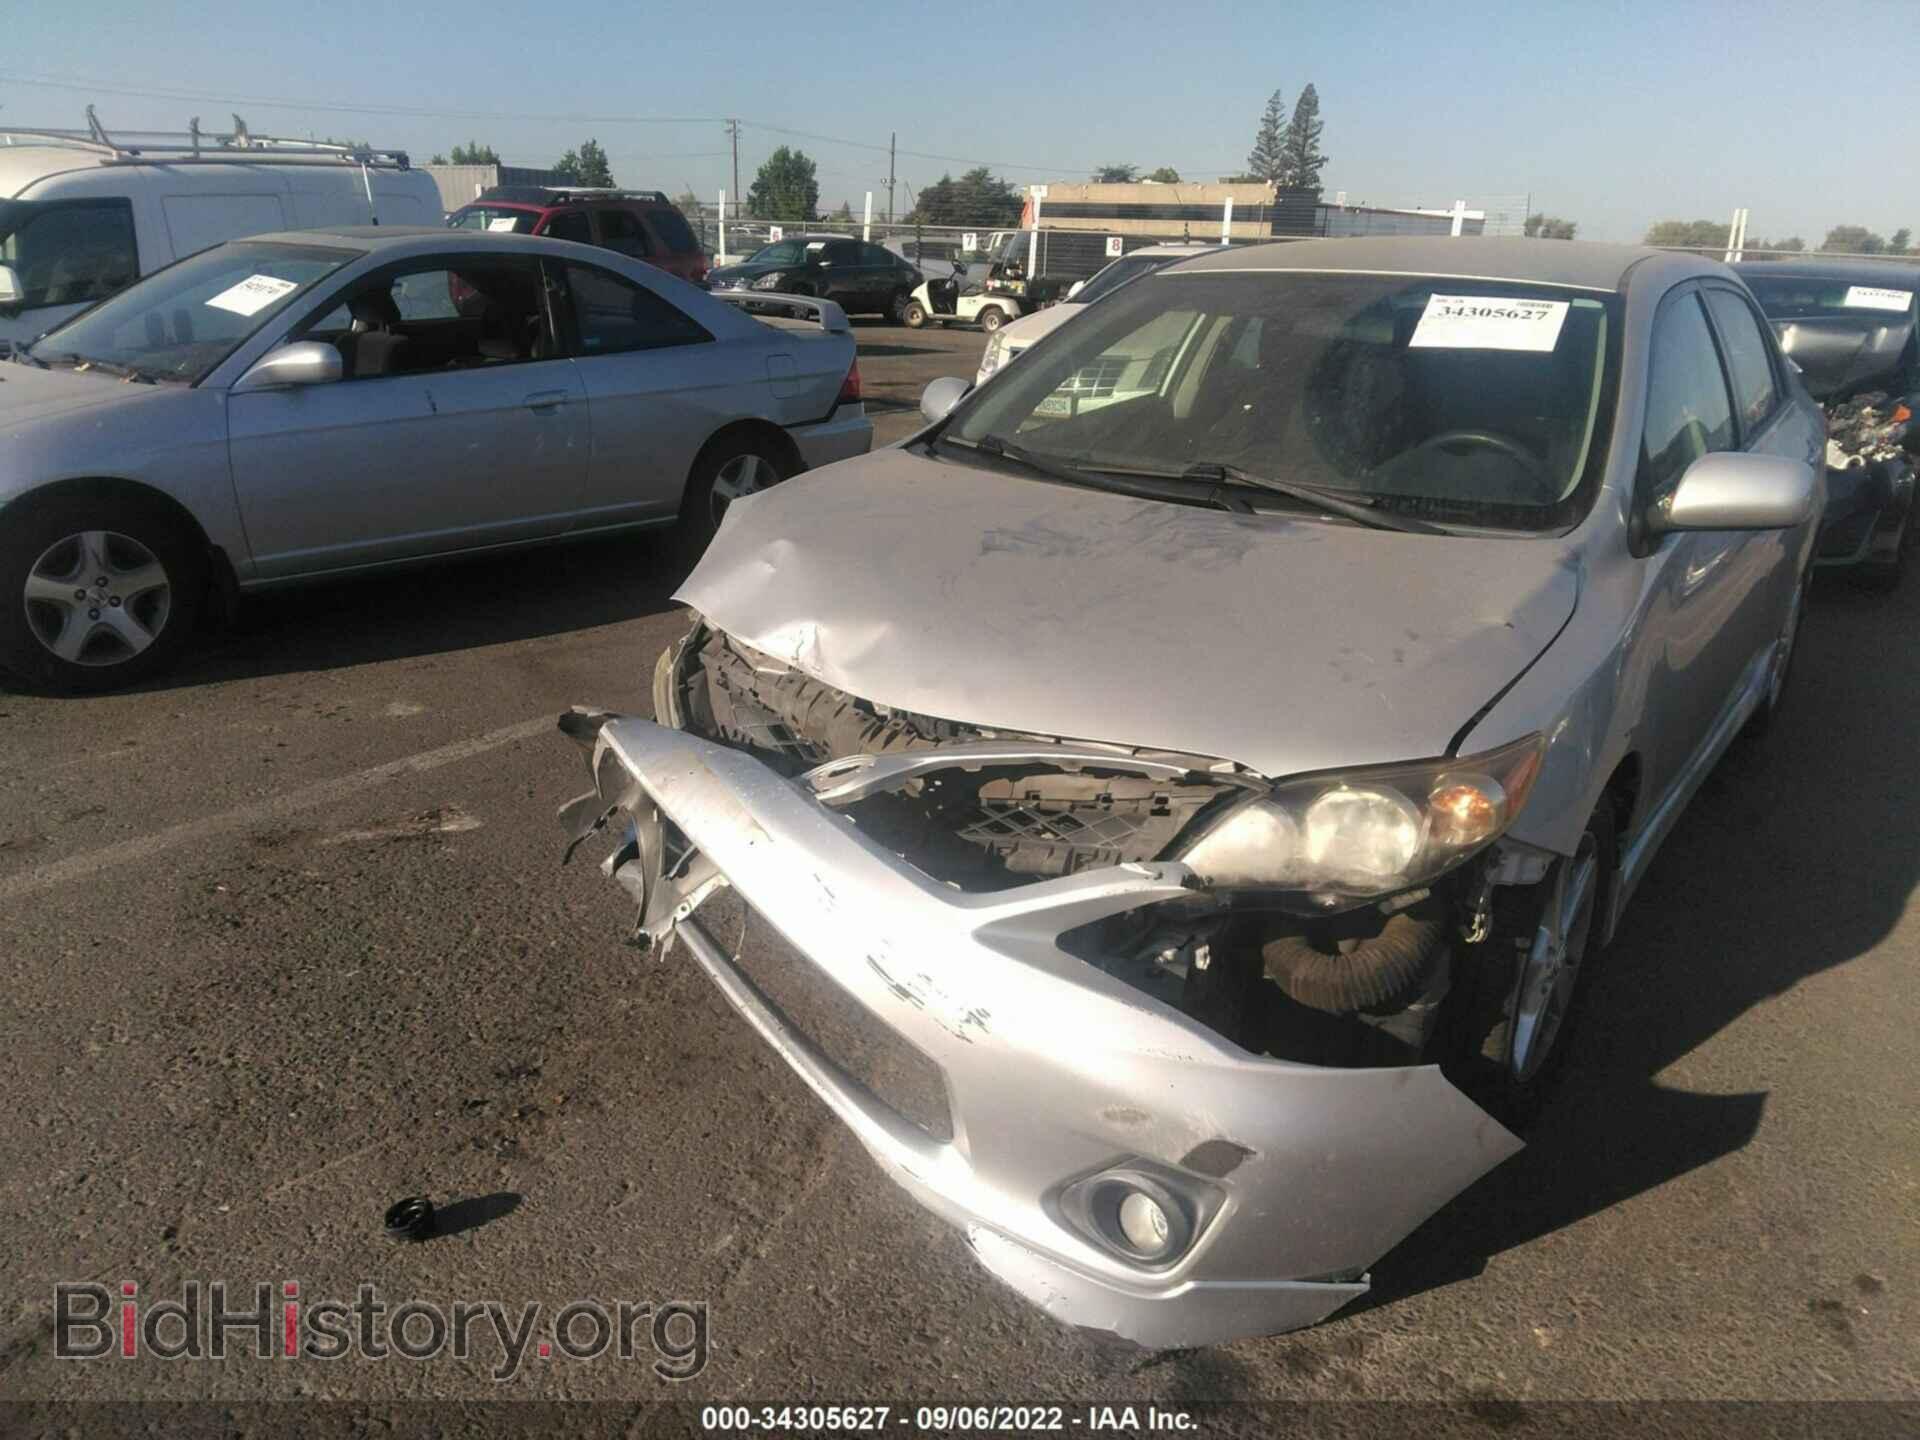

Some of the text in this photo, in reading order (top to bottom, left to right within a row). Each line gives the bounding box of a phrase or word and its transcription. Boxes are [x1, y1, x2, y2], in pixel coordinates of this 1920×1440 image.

[966, 234, 973, 247] 7
[1112, 239, 1121, 251] 8
[1438, 306, 1549, 321] 34305627
